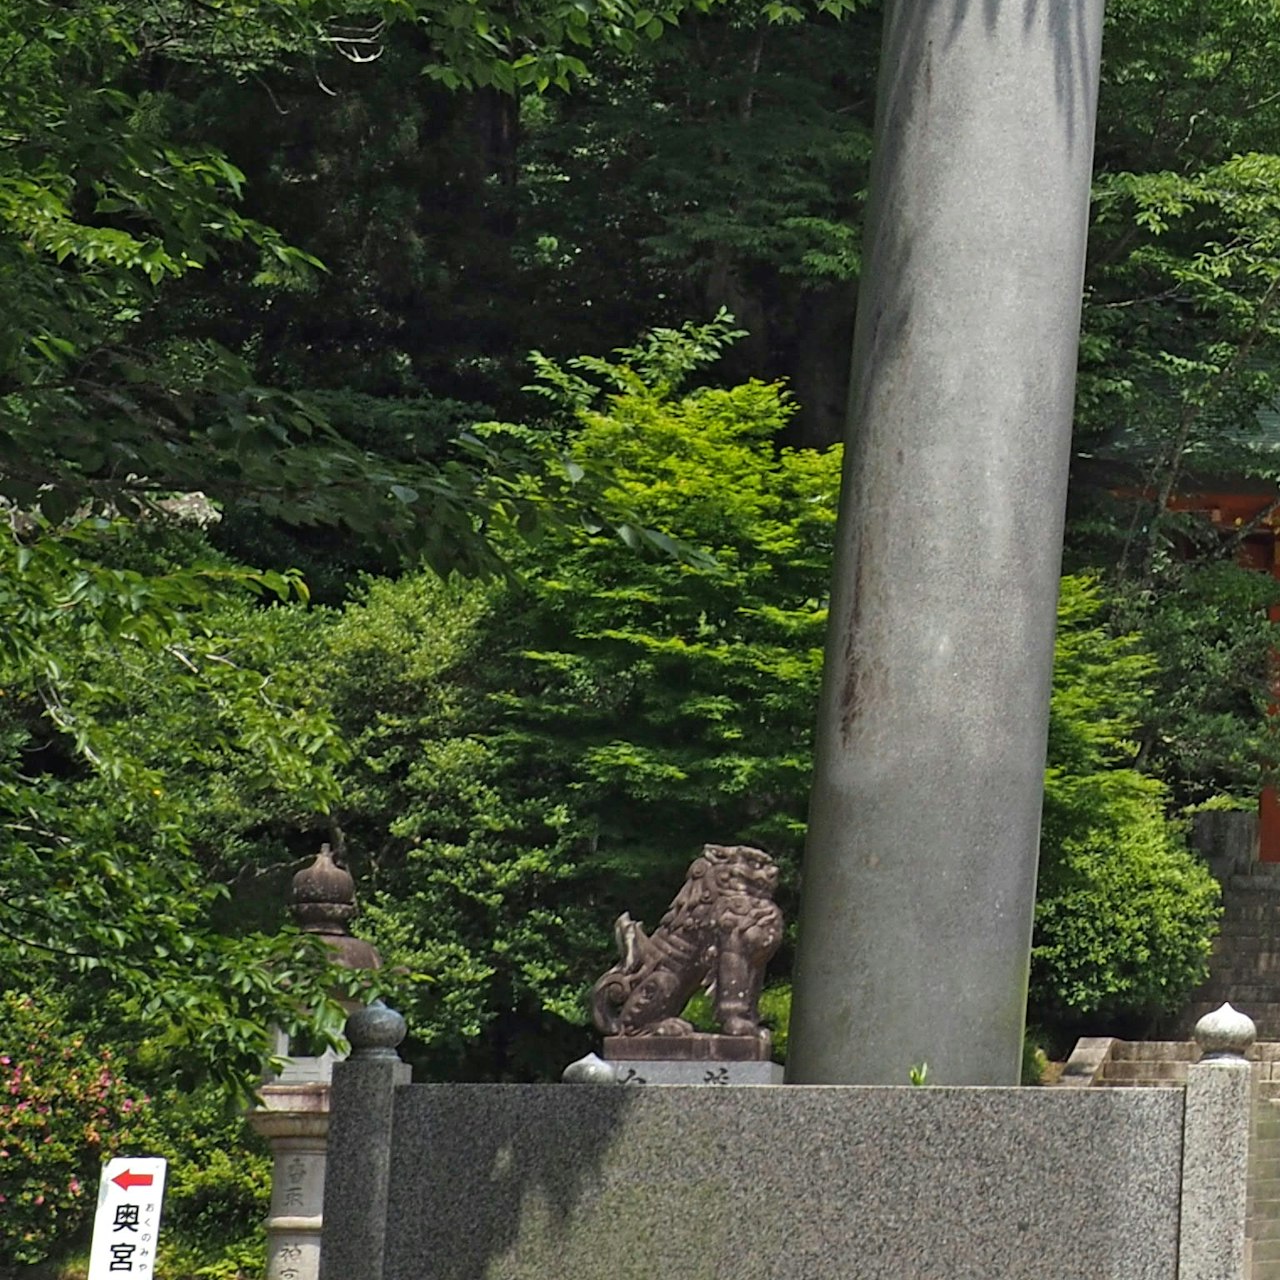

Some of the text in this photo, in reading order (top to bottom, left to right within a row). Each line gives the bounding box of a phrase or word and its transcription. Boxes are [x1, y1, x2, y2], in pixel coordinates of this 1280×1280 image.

[109, 1203, 139, 1272] 奥宮
[139, 1203, 155, 1272] おくのみや
